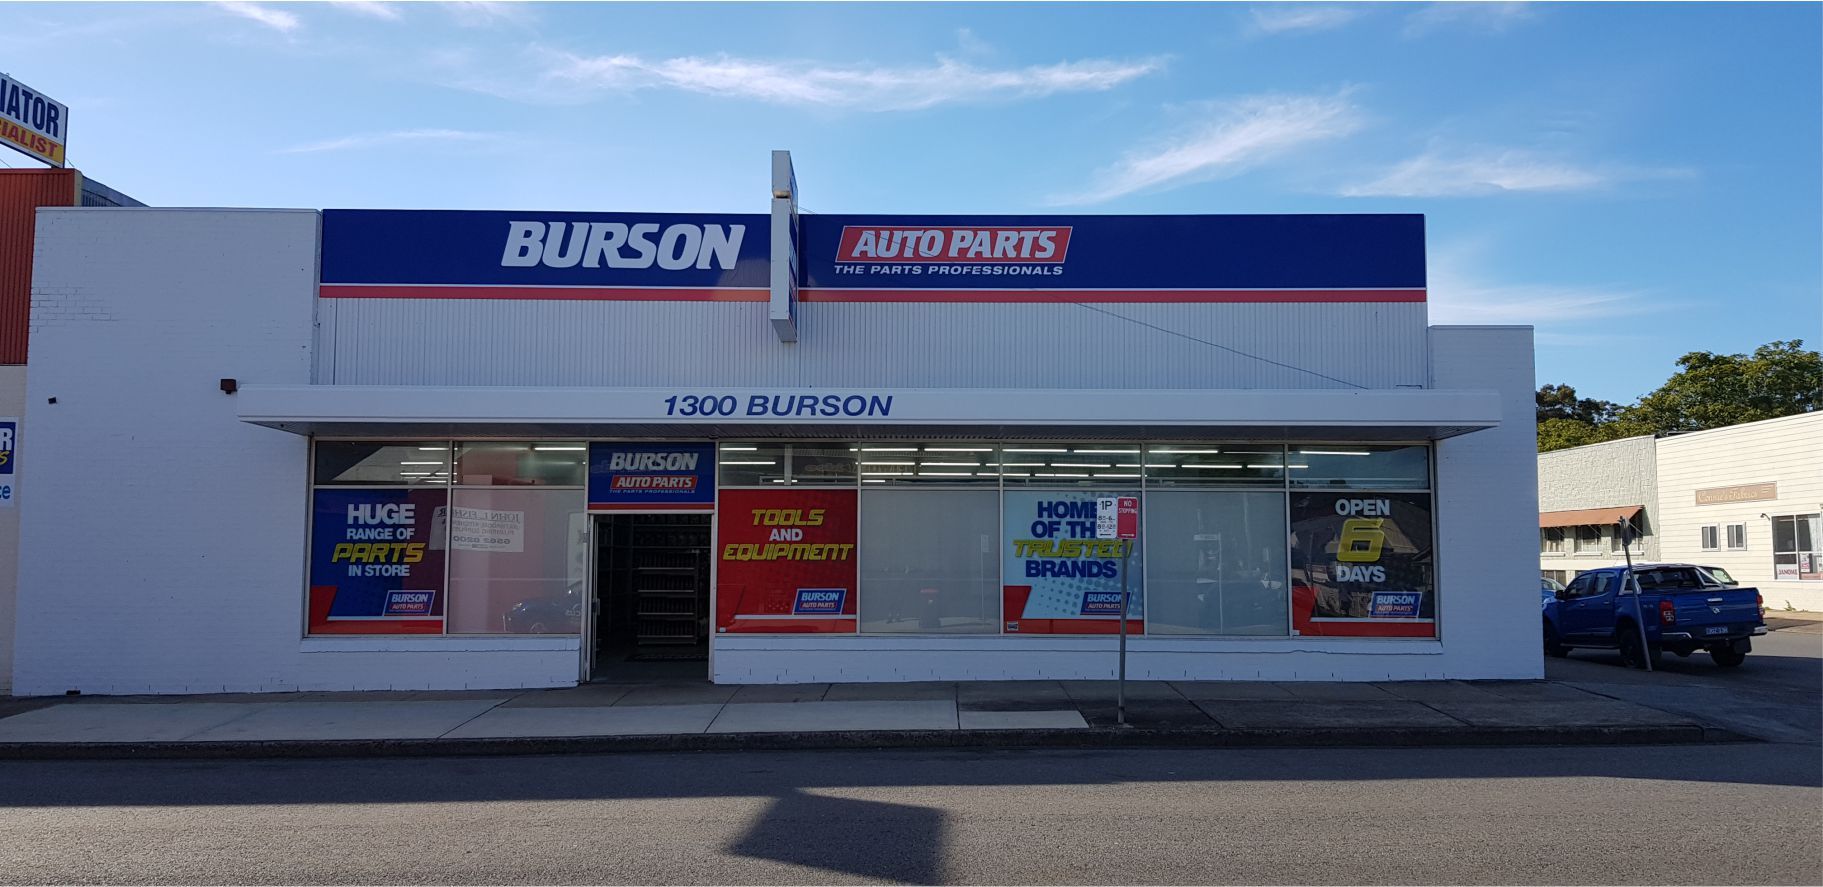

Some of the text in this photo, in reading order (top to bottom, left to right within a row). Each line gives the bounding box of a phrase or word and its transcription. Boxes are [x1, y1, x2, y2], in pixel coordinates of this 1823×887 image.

[0, 121, 58, 157] IALIST
[501, 221, 746, 271] BURSON
[851, 229, 1057, 258] AUTO PARTS
[834, 265, 1064, 276] THE PARTS PROFESSIONALS
[664, 395, 893, 416] 1300 BURSON
[609, 452, 699, 471] BURSON
[616, 476, 692, 488] AUTO PARTS
[347, 503, 416, 525] HUGE
[1101, 501, 1112, 510] 1P
[1335, 499, 1391, 516] OPEN
[752, 509, 826, 526] TOOLS
[346, 528, 415, 540] RANGE OF
[769, 528, 803, 541] AND
[1031, 520, 1061, 539] OF
[1066, 520, 1097, 539] TH
[1336, 519, 1385, 562] 6
[331, 542, 426, 563] PARTS
[722, 543, 854, 561] EQUIPMENT
[348, 564, 411, 577] IN STORE
[1025, 560, 1118, 578] BRANDS
[1336, 565, 1386, 582] DAYS
[391, 593, 429, 603] BURSON
[801, 592, 840, 601] BURSON
[1376, 595, 1416, 605] BURSON
